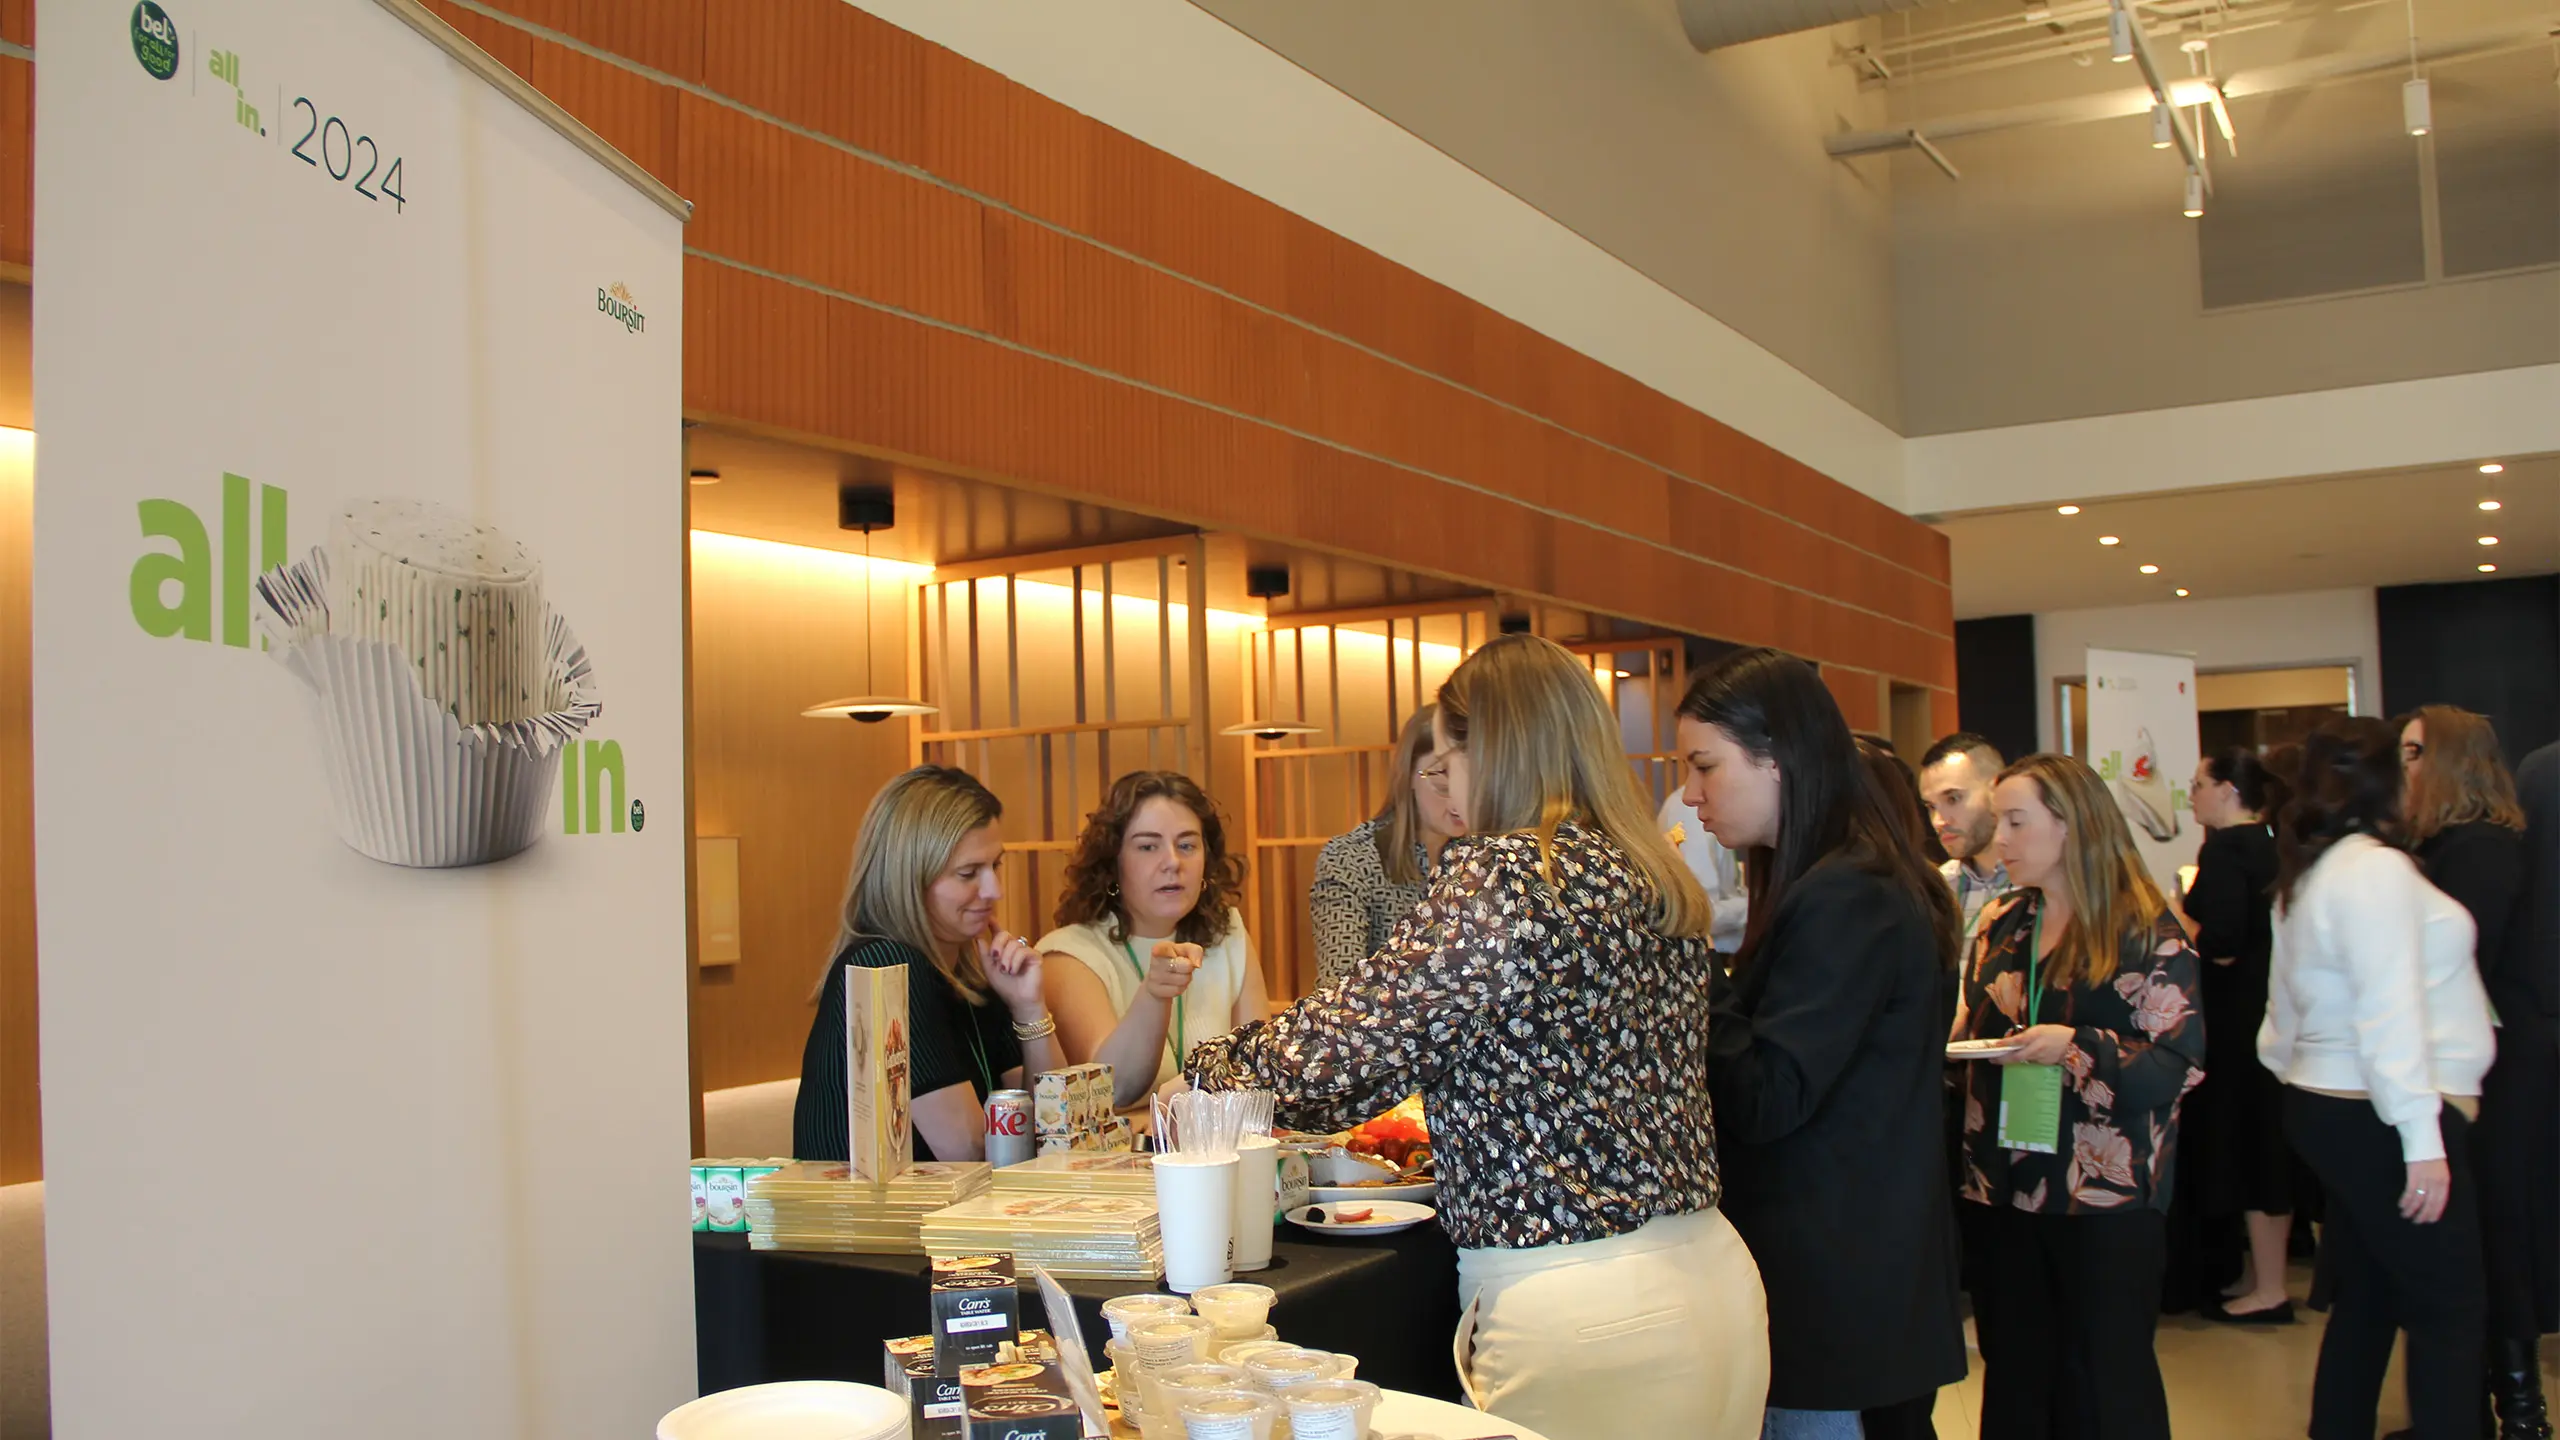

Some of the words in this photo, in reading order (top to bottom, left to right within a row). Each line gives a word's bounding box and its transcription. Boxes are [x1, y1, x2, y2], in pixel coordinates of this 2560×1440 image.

[141, 4, 172, 45] bel
[209, 48, 239, 88] all
[292, 96, 406, 214] 2024
[130, 470, 288, 652] all
[2100, 750, 2122, 780] all
[709, 1182, 738, 1193] boursin
[958, 1297, 991, 1311] Carr's
[936, 1383, 961, 1397] Carr
